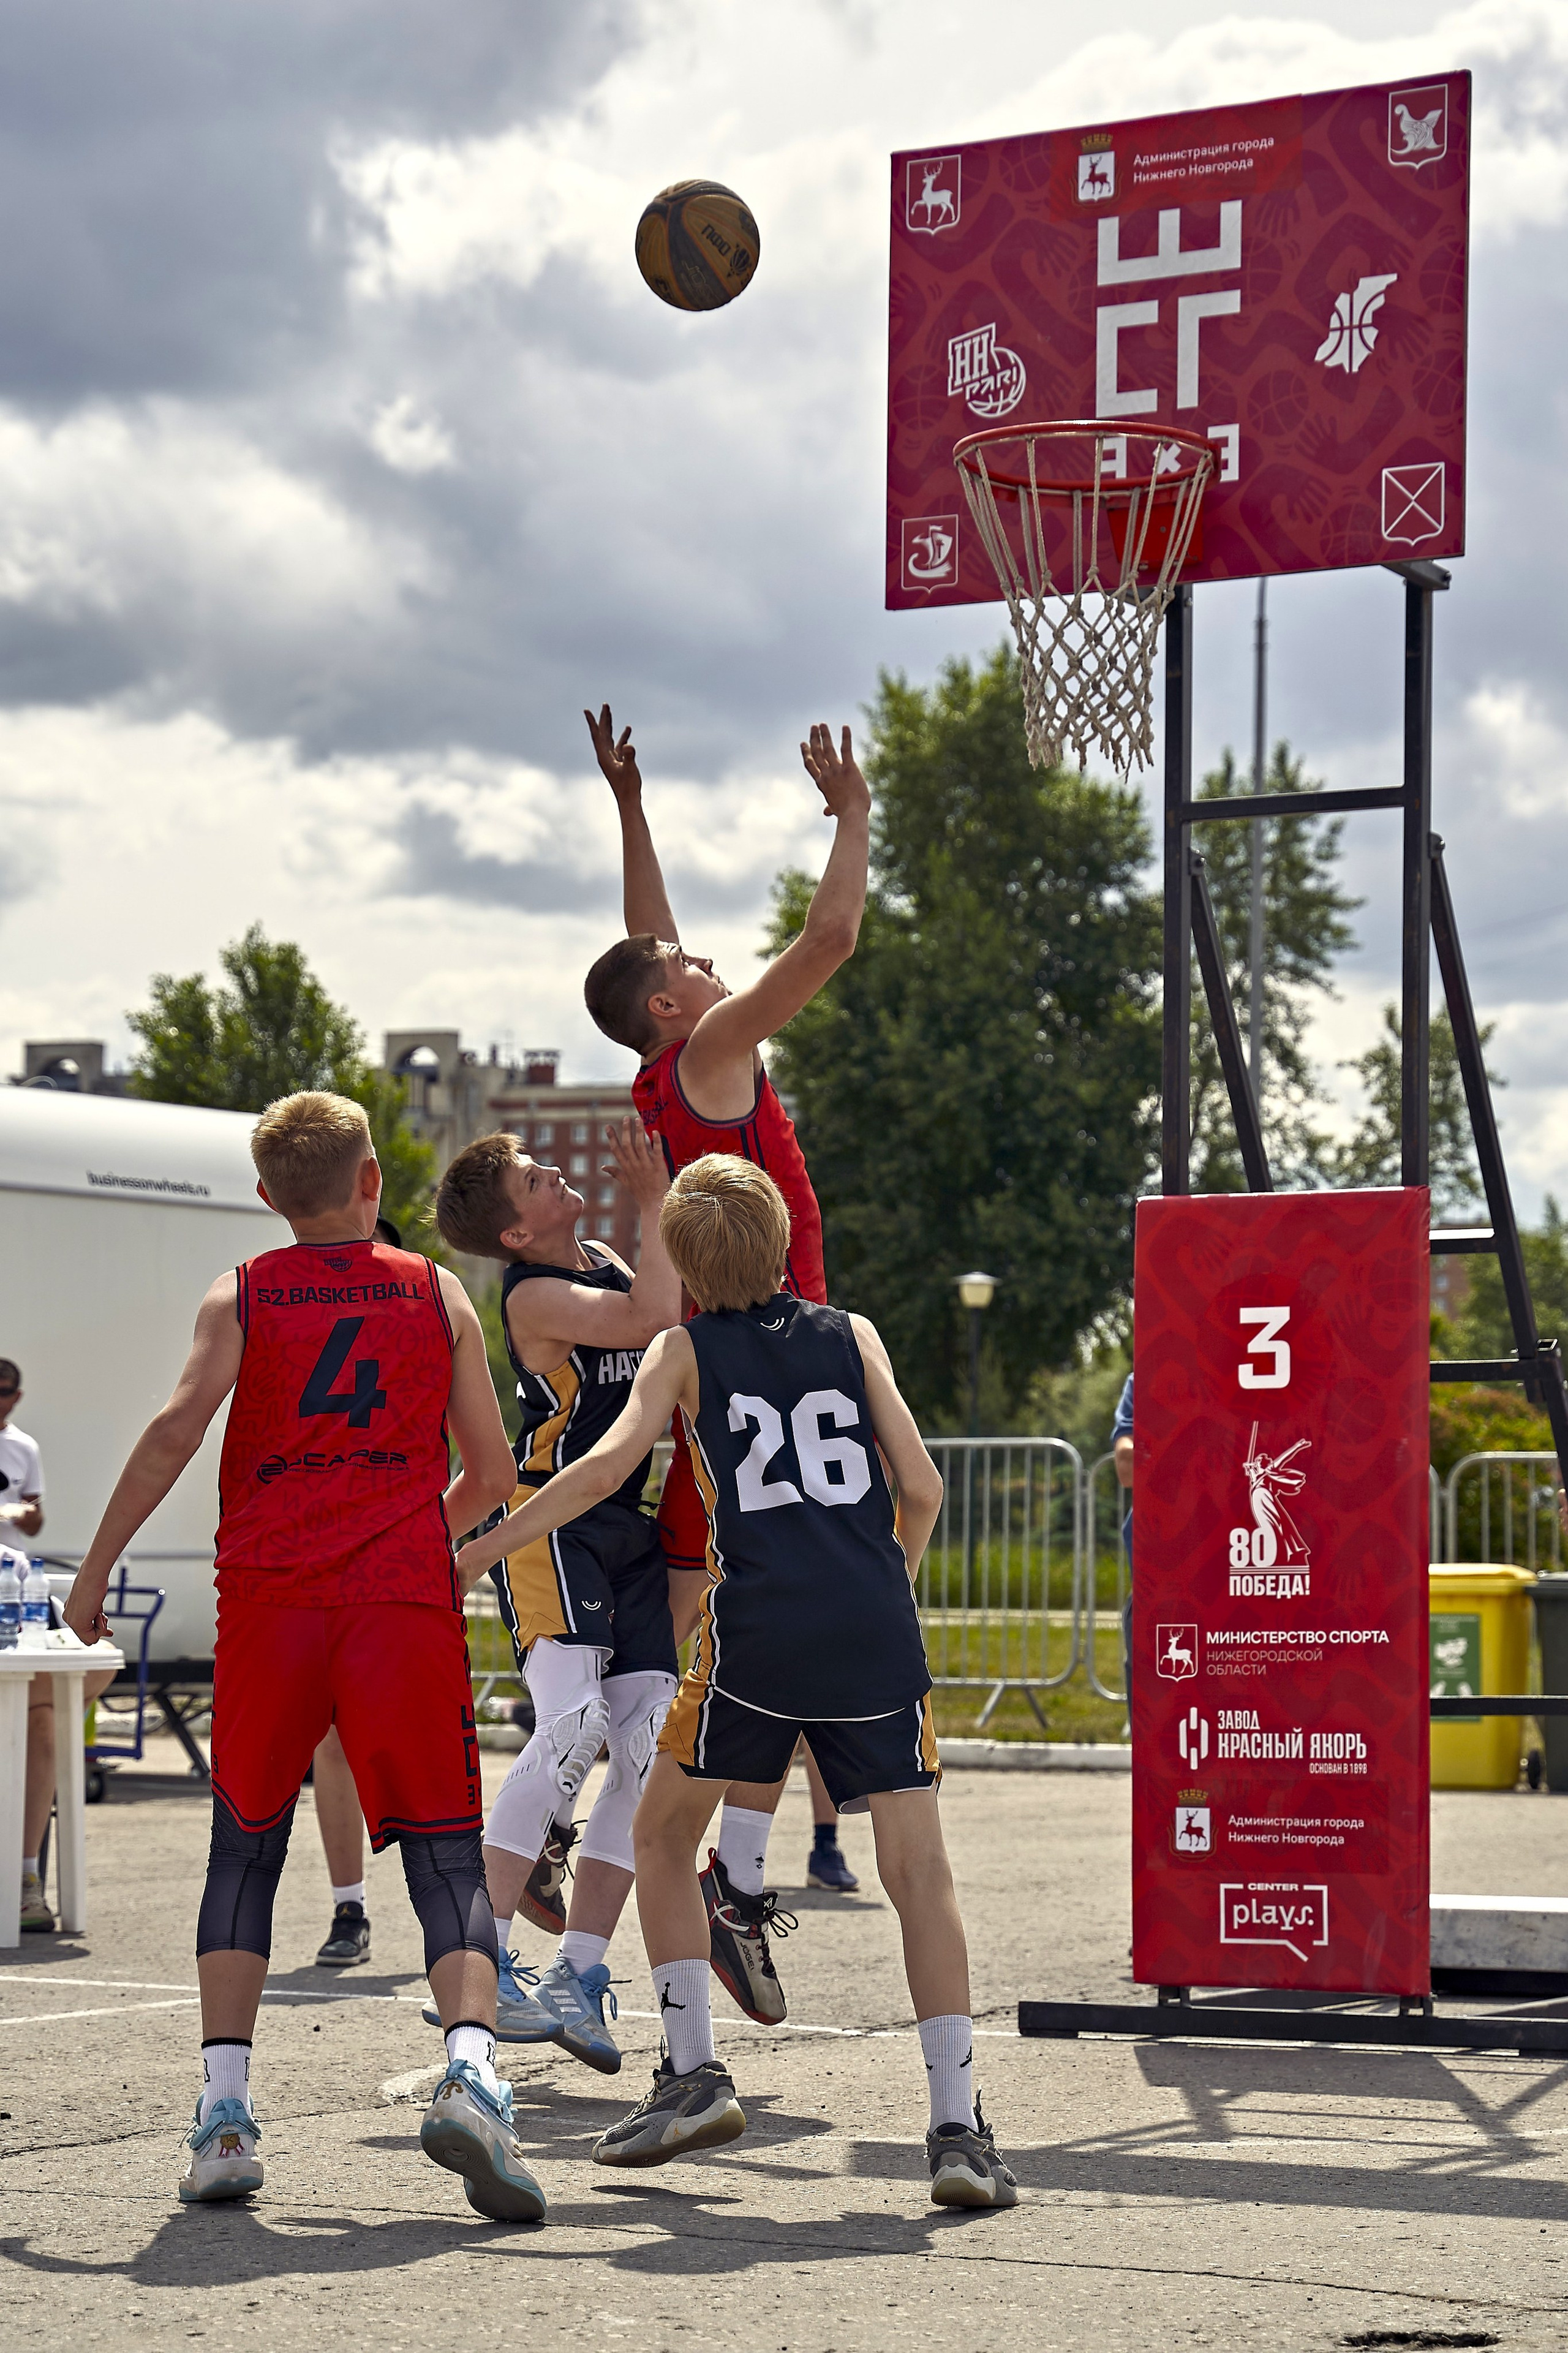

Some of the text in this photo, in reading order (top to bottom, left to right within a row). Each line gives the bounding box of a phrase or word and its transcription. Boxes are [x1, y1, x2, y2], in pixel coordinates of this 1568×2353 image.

[1134, 137, 1275, 166] Администрация города
[1133, 158, 1254, 184] Нижнего Новгорода
[257, 1282, 424, 1305] 52.BASKETBALL
[1238, 1306, 1291, 1389] 3
[299, 1316, 386, 1428] 4
[727, 1389, 872, 1512] 26
[1229, 1527, 1278, 1567] 80
[1229, 1575, 1310, 1599] ПОБЕДА!
[1207, 1630, 1390, 1644] МИНИСТЕРСТВО СПОРТА
[1207, 1647, 1323, 1662] НИЖЕГОРОДСКОЙ
[1207, 1664, 1267, 1675] ОБЛАСТИ
[1218, 1710, 1261, 1730] ЗАВОД
[1218, 1728, 1367, 1759] КРАСНЫЙ ЯКОРЬ
[1309, 1762, 1342, 1774] ОСНОВАН
[1349, 1763, 1368, 1774] 1898
[1228, 1815, 1365, 1829] Администрация города
[1228, 1832, 1345, 1846] Нижнего Новгорода
[1248, 1883, 1299, 1892] CENTER
